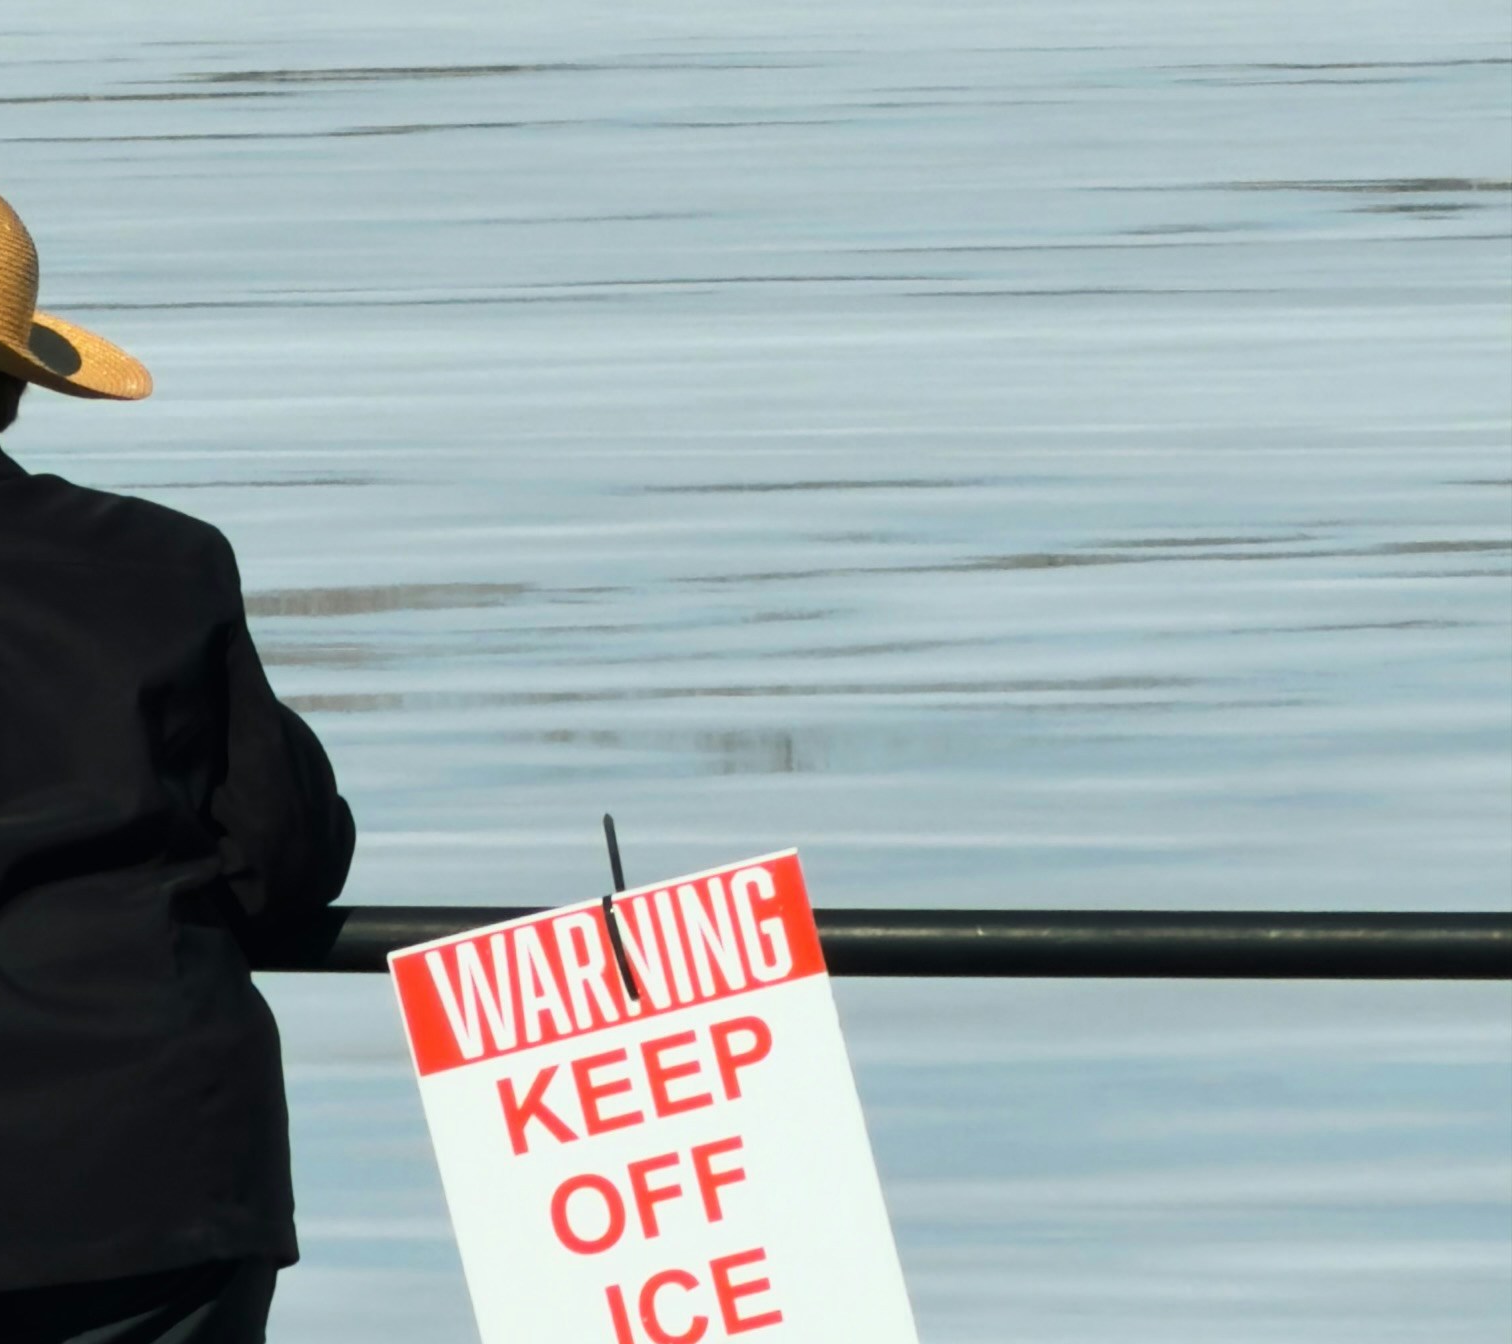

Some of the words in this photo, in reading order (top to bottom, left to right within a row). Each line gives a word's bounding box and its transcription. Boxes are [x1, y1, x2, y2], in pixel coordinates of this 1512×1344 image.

[424, 866, 794, 1060] WARNING
[497, 1016, 772, 1155] KEEP
[550, 1137, 746, 1256] OFF
